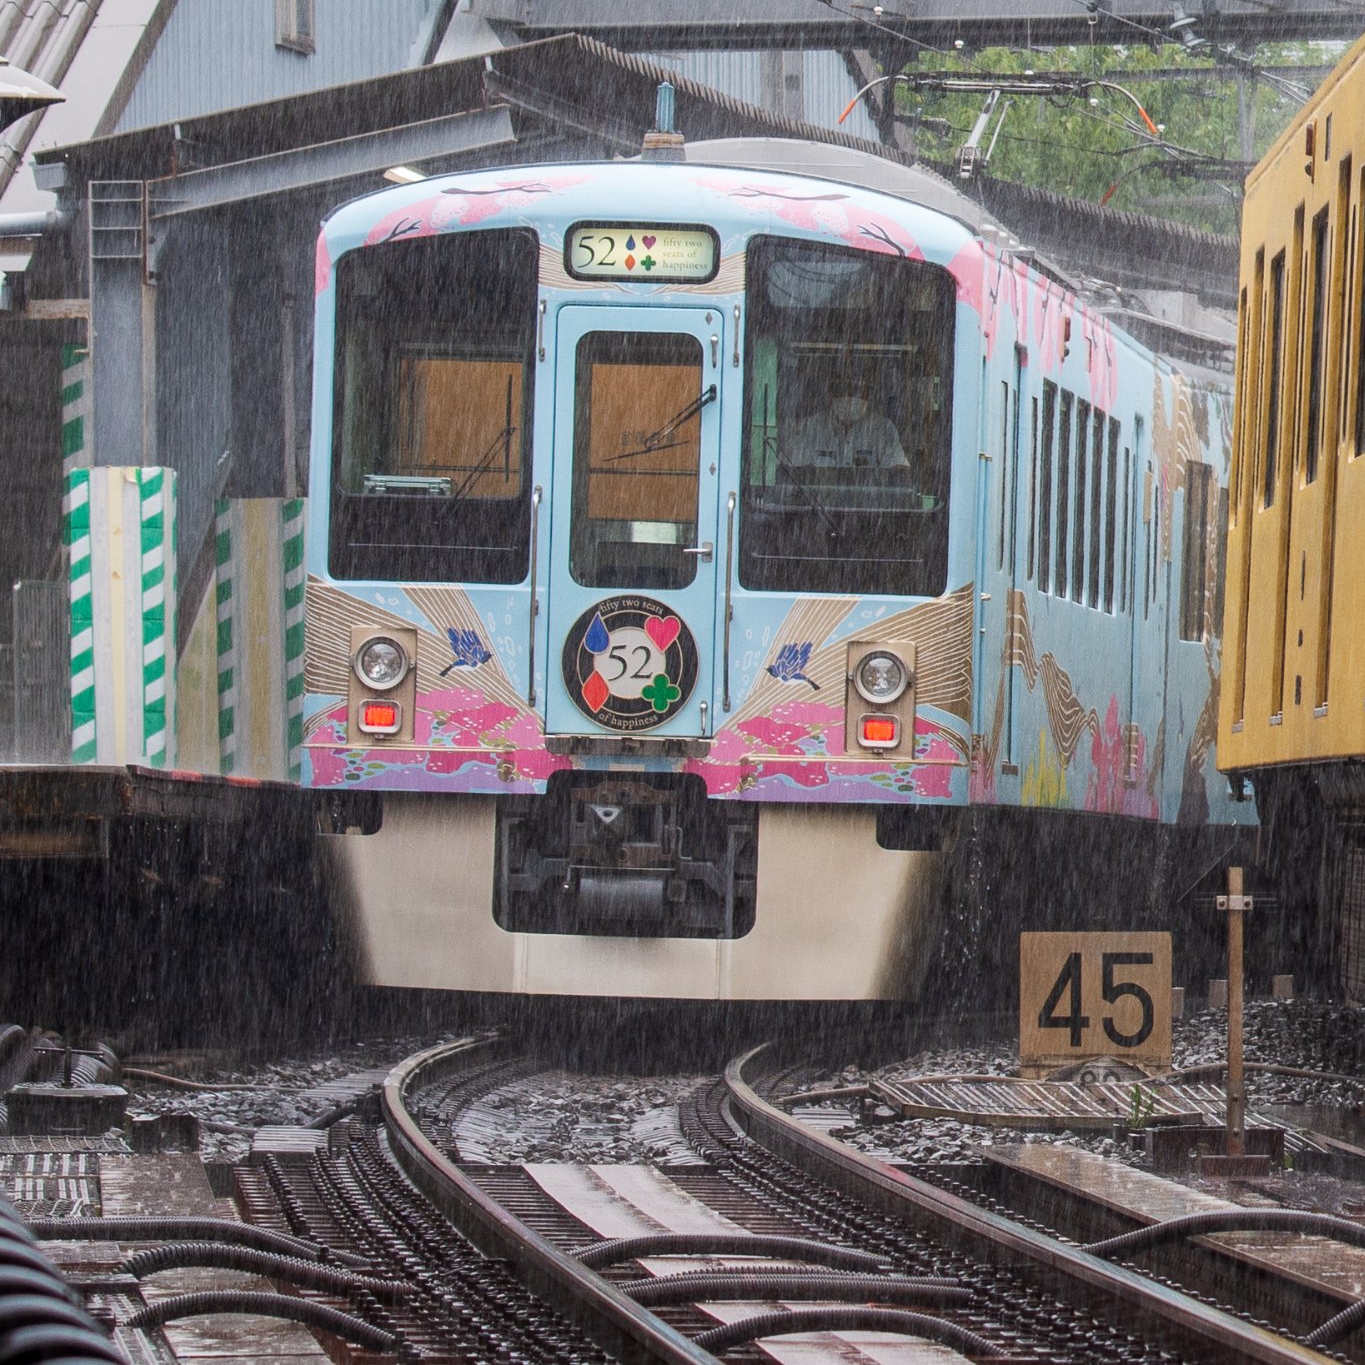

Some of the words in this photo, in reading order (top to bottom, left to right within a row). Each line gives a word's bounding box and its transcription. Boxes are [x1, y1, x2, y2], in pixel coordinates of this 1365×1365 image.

[663, 237, 682, 248] fifty
[685, 239, 703, 247] two
[577, 236, 616, 268] 52
[663, 250, 684, 258] seats
[687, 250, 697, 259] of
[662, 259, 708, 271] happiness
[600, 600, 620, 613] fifty
[622, 598, 640, 607] two
[642, 601, 664, 615] seats
[608, 645, 654, 682] 52
[598, 713, 610, 722] of
[611, 714, 658, 730] happiness
[1038, 952, 1154, 1048] 45
